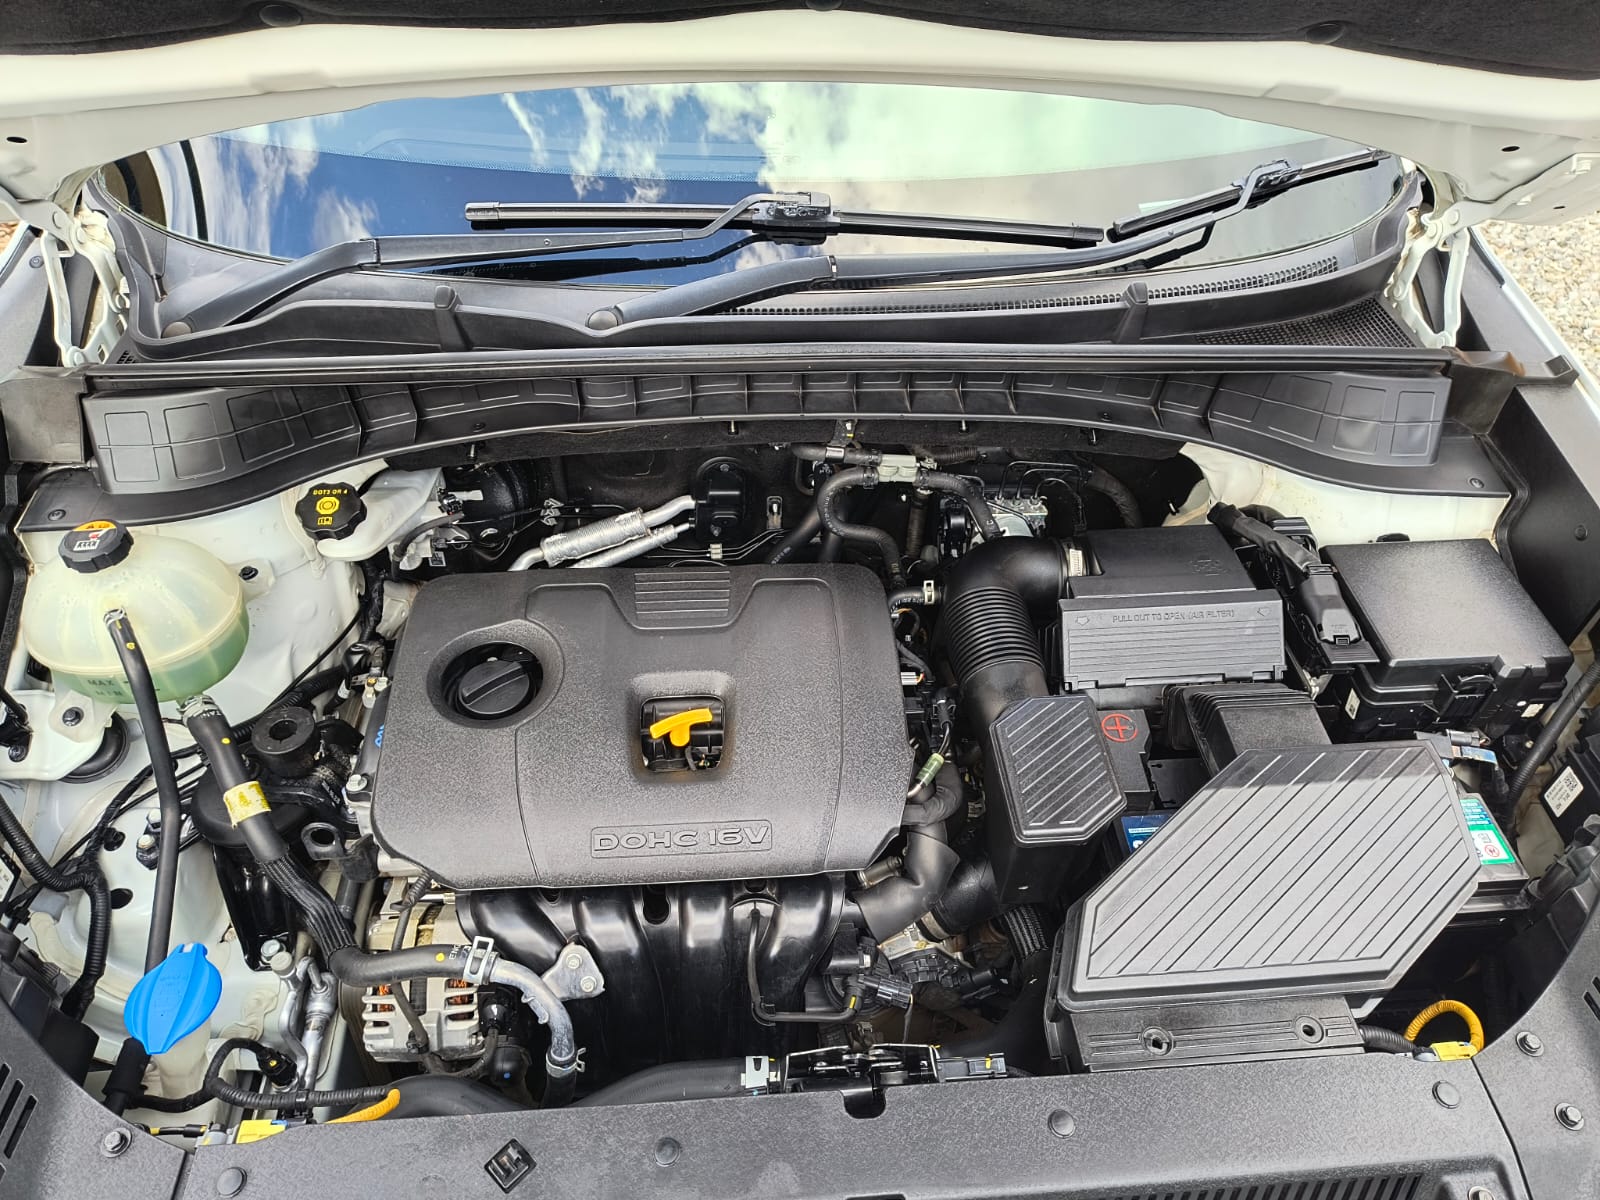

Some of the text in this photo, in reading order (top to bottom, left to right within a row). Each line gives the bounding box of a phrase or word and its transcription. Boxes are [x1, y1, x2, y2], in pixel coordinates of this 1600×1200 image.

[1112, 615, 1133, 623] PULL
[1134, 614, 1150, 622] OUT
[1151, 613, 1162, 621] TO
[1164, 612, 1186, 620] OPEN
[594, 826, 769, 852] DOHC 16V
